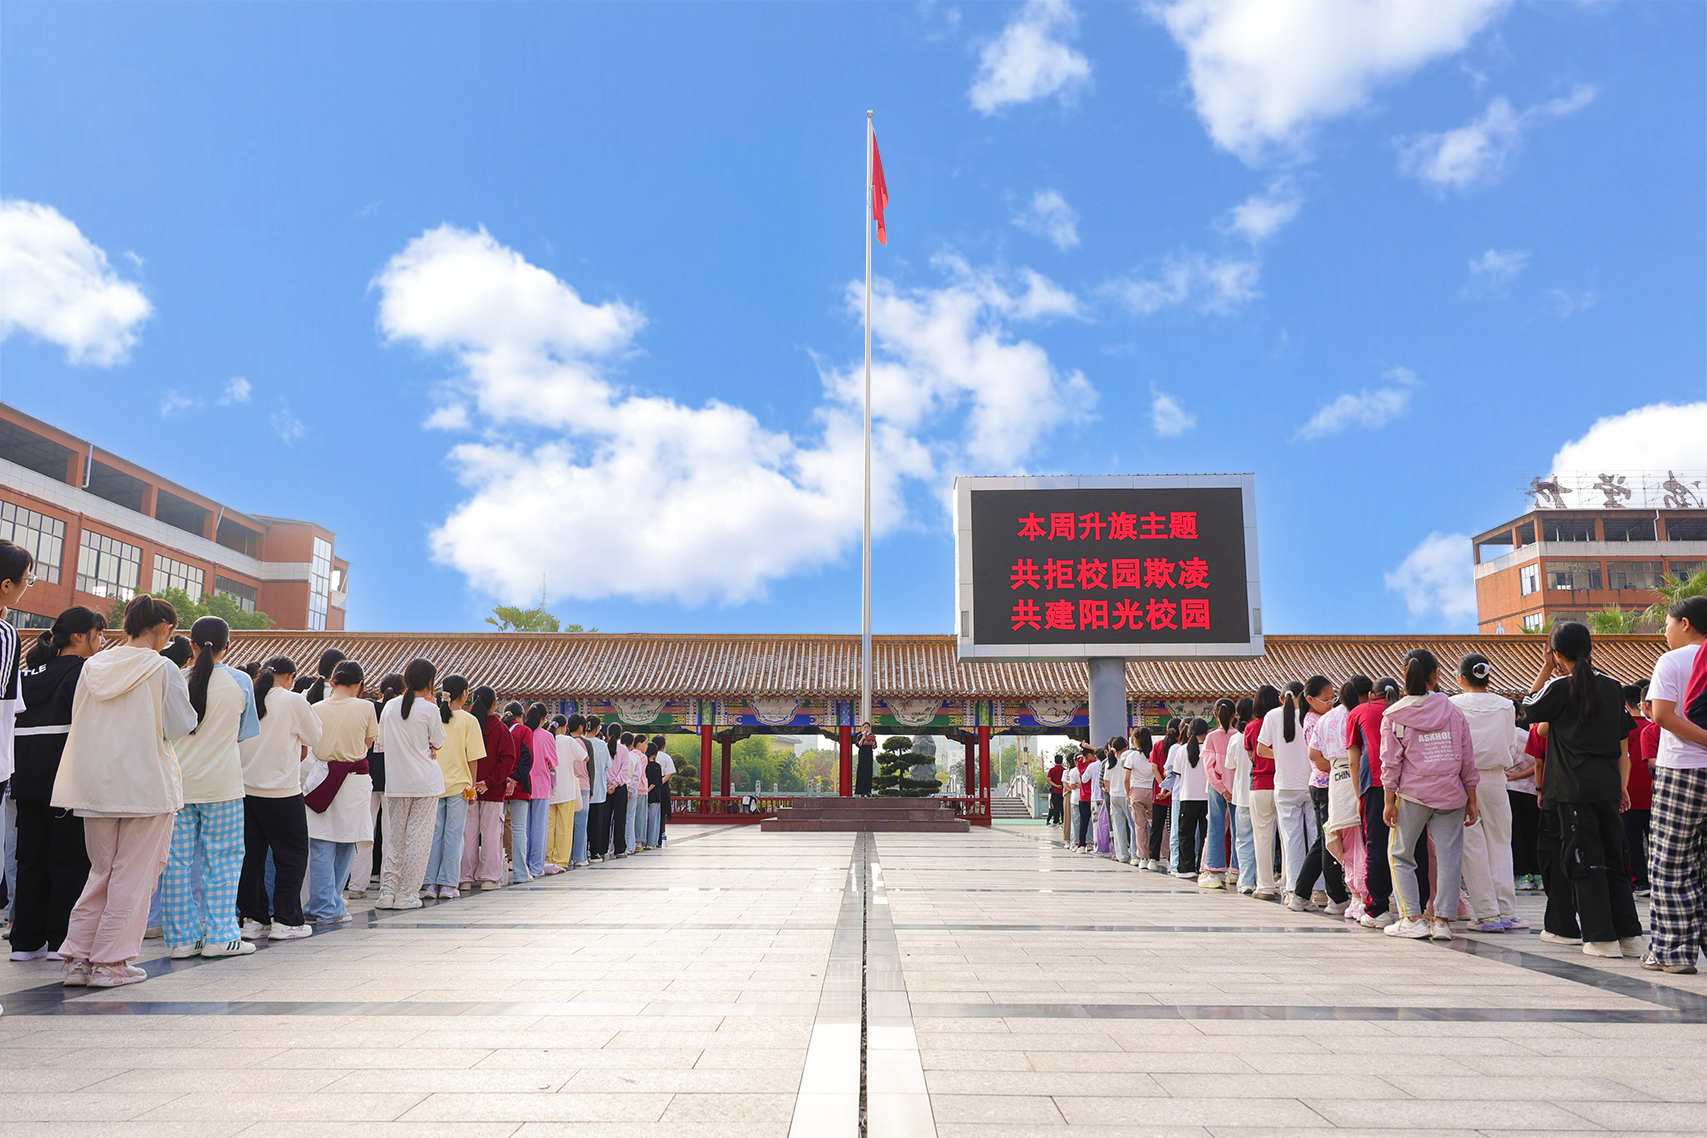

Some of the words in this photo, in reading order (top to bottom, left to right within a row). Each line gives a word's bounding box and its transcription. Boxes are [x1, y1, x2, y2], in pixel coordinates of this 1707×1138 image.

[1017, 511, 1199, 542] 本周升旗主题
[1010, 557, 1210, 590] 共拒校园欺凌
[1011, 598, 1212, 631] 共建阳光校园
